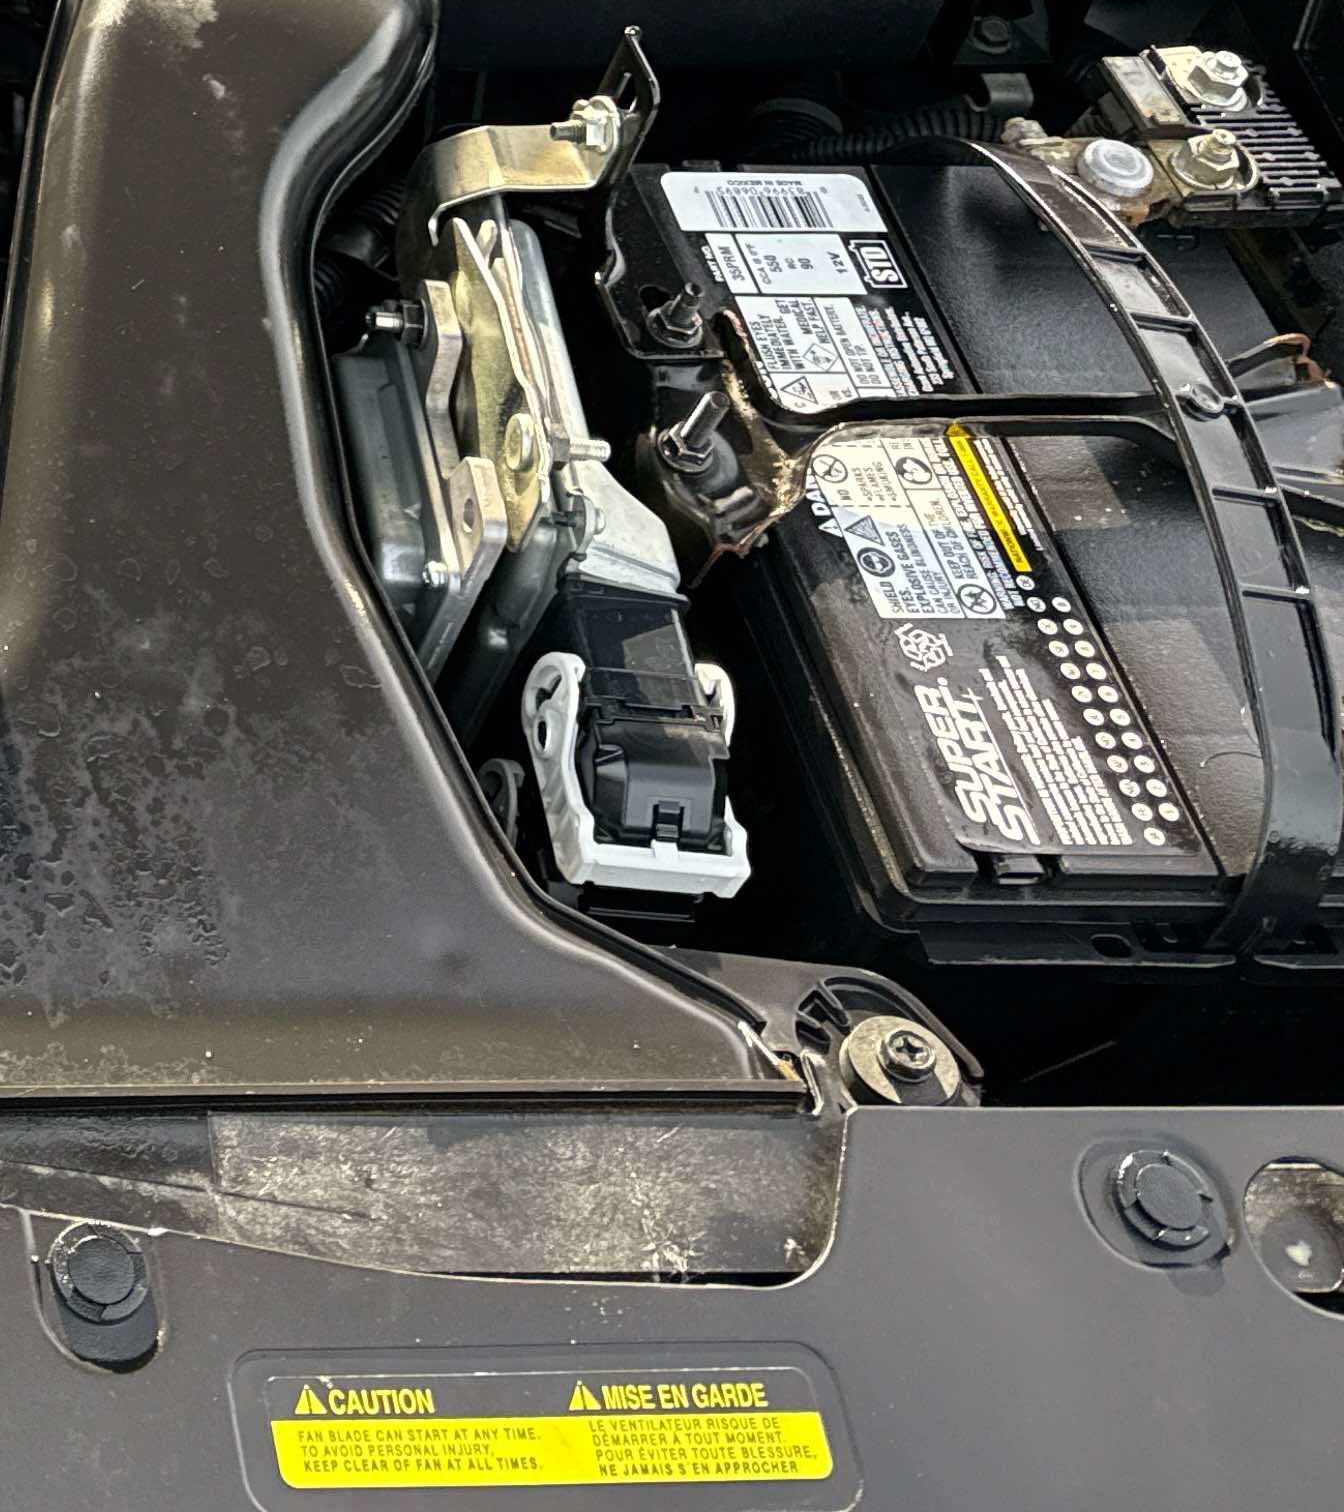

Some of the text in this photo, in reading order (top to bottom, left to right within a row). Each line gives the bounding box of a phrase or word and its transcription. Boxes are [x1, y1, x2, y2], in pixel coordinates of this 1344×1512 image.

[716, 245, 745, 280] 35PRM
[762, 255, 783, 272] 550
[797, 257, 814, 269] 90
[826, 251, 848, 273] 12V
[858, 246, 900, 282] STD
[773, 298, 792, 313] GET
[930, 528, 946, 539] OF
[884, 531, 910, 559] GASES
[936, 541, 955, 557] OUT
[945, 559, 965, 578] KEEP
[900, 563, 935, 613] EXPLOSIVE
[917, 569, 940, 594] CAUSE
[878, 581, 905, 613] SHIELD
[931, 597, 949, 613] CAN
[914, 684, 988, 823] SUPER
[938, 686, 1041, 845] START
[328, 1388, 436, 1415] CAUTION
[601, 1383, 769, 1410] MISE EN GARDE
[589, 1417, 779, 1432] LE VENTILATEUR RISQUE DE
[298, 1427, 542, 1443] FAN BLADE CAN START AT ANY TIME.
[593, 1431, 667, 1446] DÉMARRER
[673, 1431, 682, 1445] À
[686, 1433, 721, 1445] TOUT
[301, 1445, 319, 1458] TO
[323, 1445, 363, 1457] AVOID
[368, 1443, 439, 1457] PERSONAL
[595, 1445, 817, 1461] POUR ÉVITER TOUTE BLESSURE,
[304, 1457, 543, 1473] KEEP CLEAR OF FAN AT ALL TIMES.
[599, 1464, 617, 1477] NE
[623, 1463, 673, 1476] JAMAIS
[715, 1461, 799, 1474] APPROCHER
